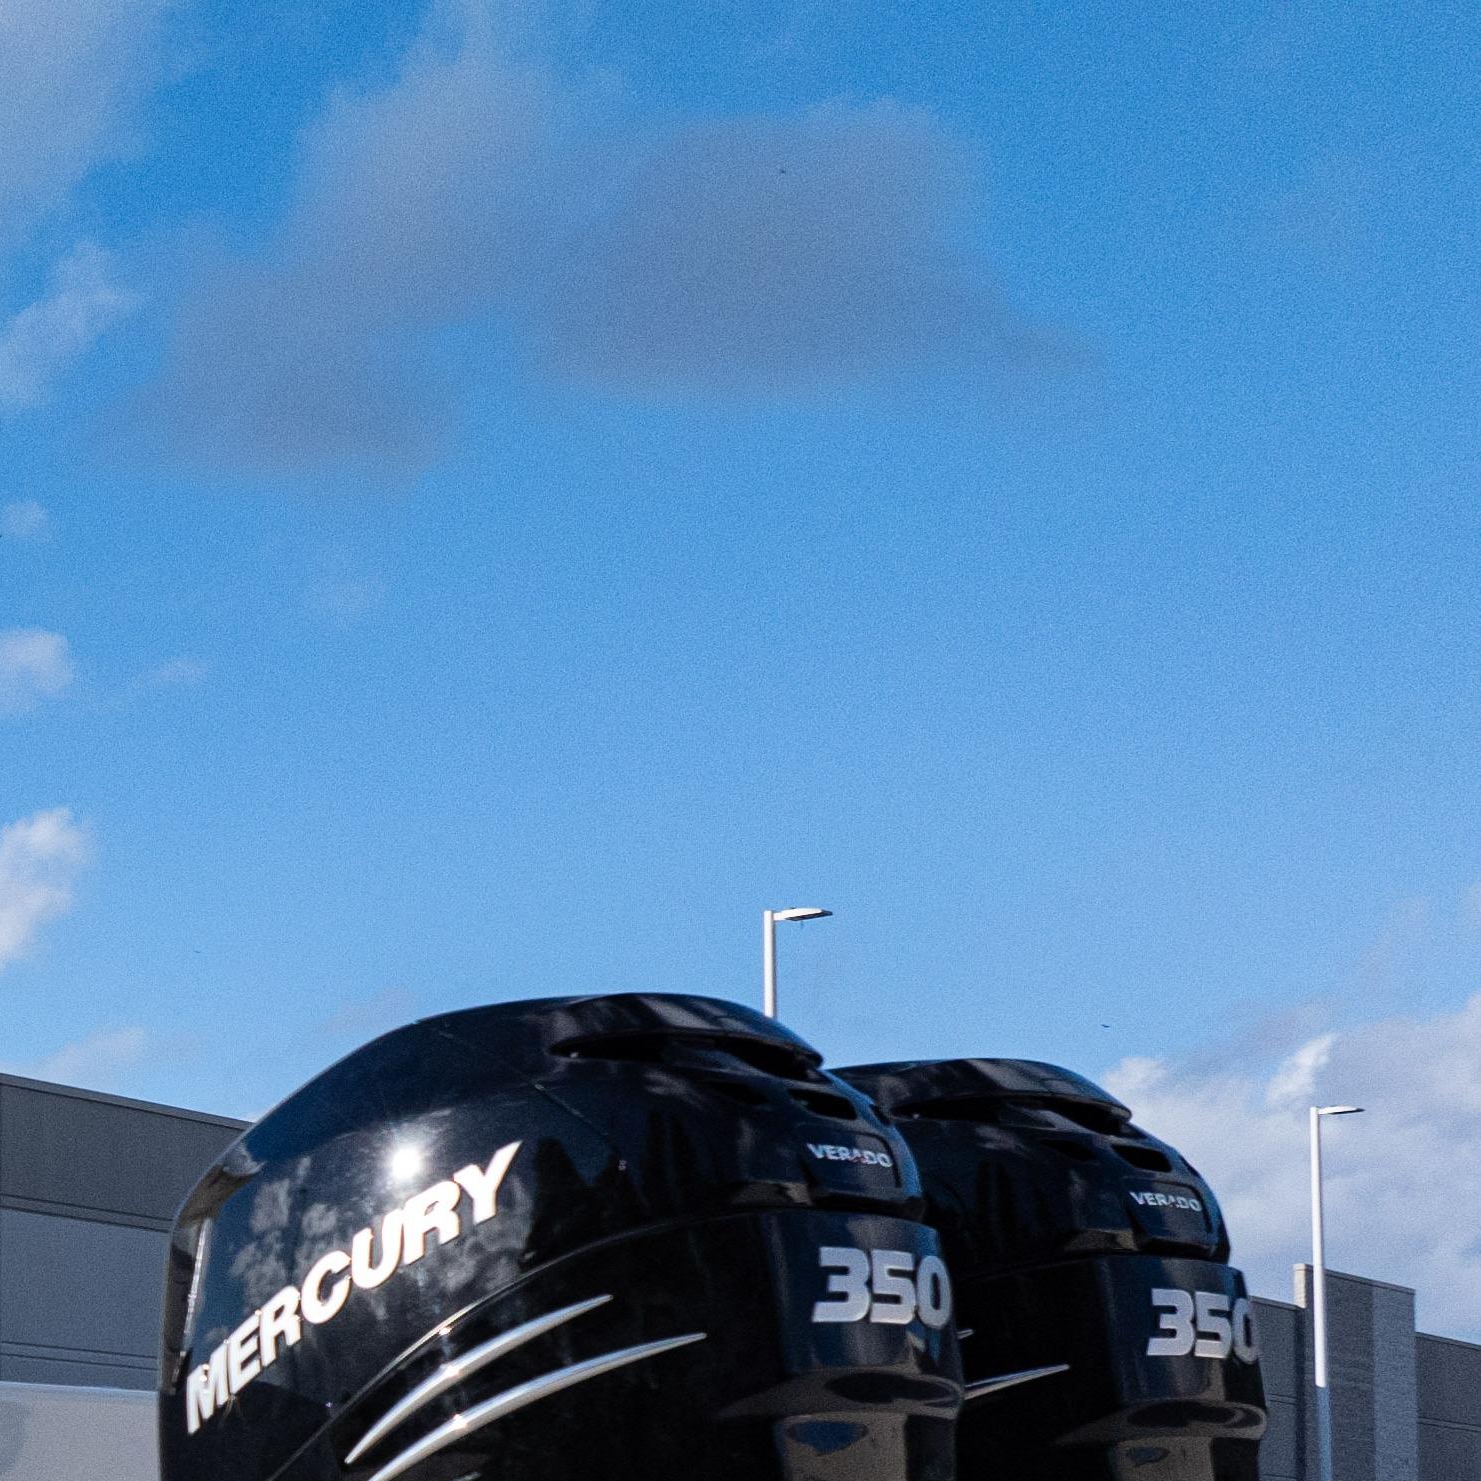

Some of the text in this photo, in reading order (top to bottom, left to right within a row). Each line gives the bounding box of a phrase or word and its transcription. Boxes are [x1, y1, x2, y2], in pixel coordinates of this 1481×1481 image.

[805, 1142, 894, 1168] VERADO
[1128, 1191, 1203, 1212] VERADO
[187, 1140, 523, 1436] MERCURY
[811, 1246, 952, 1330] 350
[1146, 1287, 1260, 1366] 350
